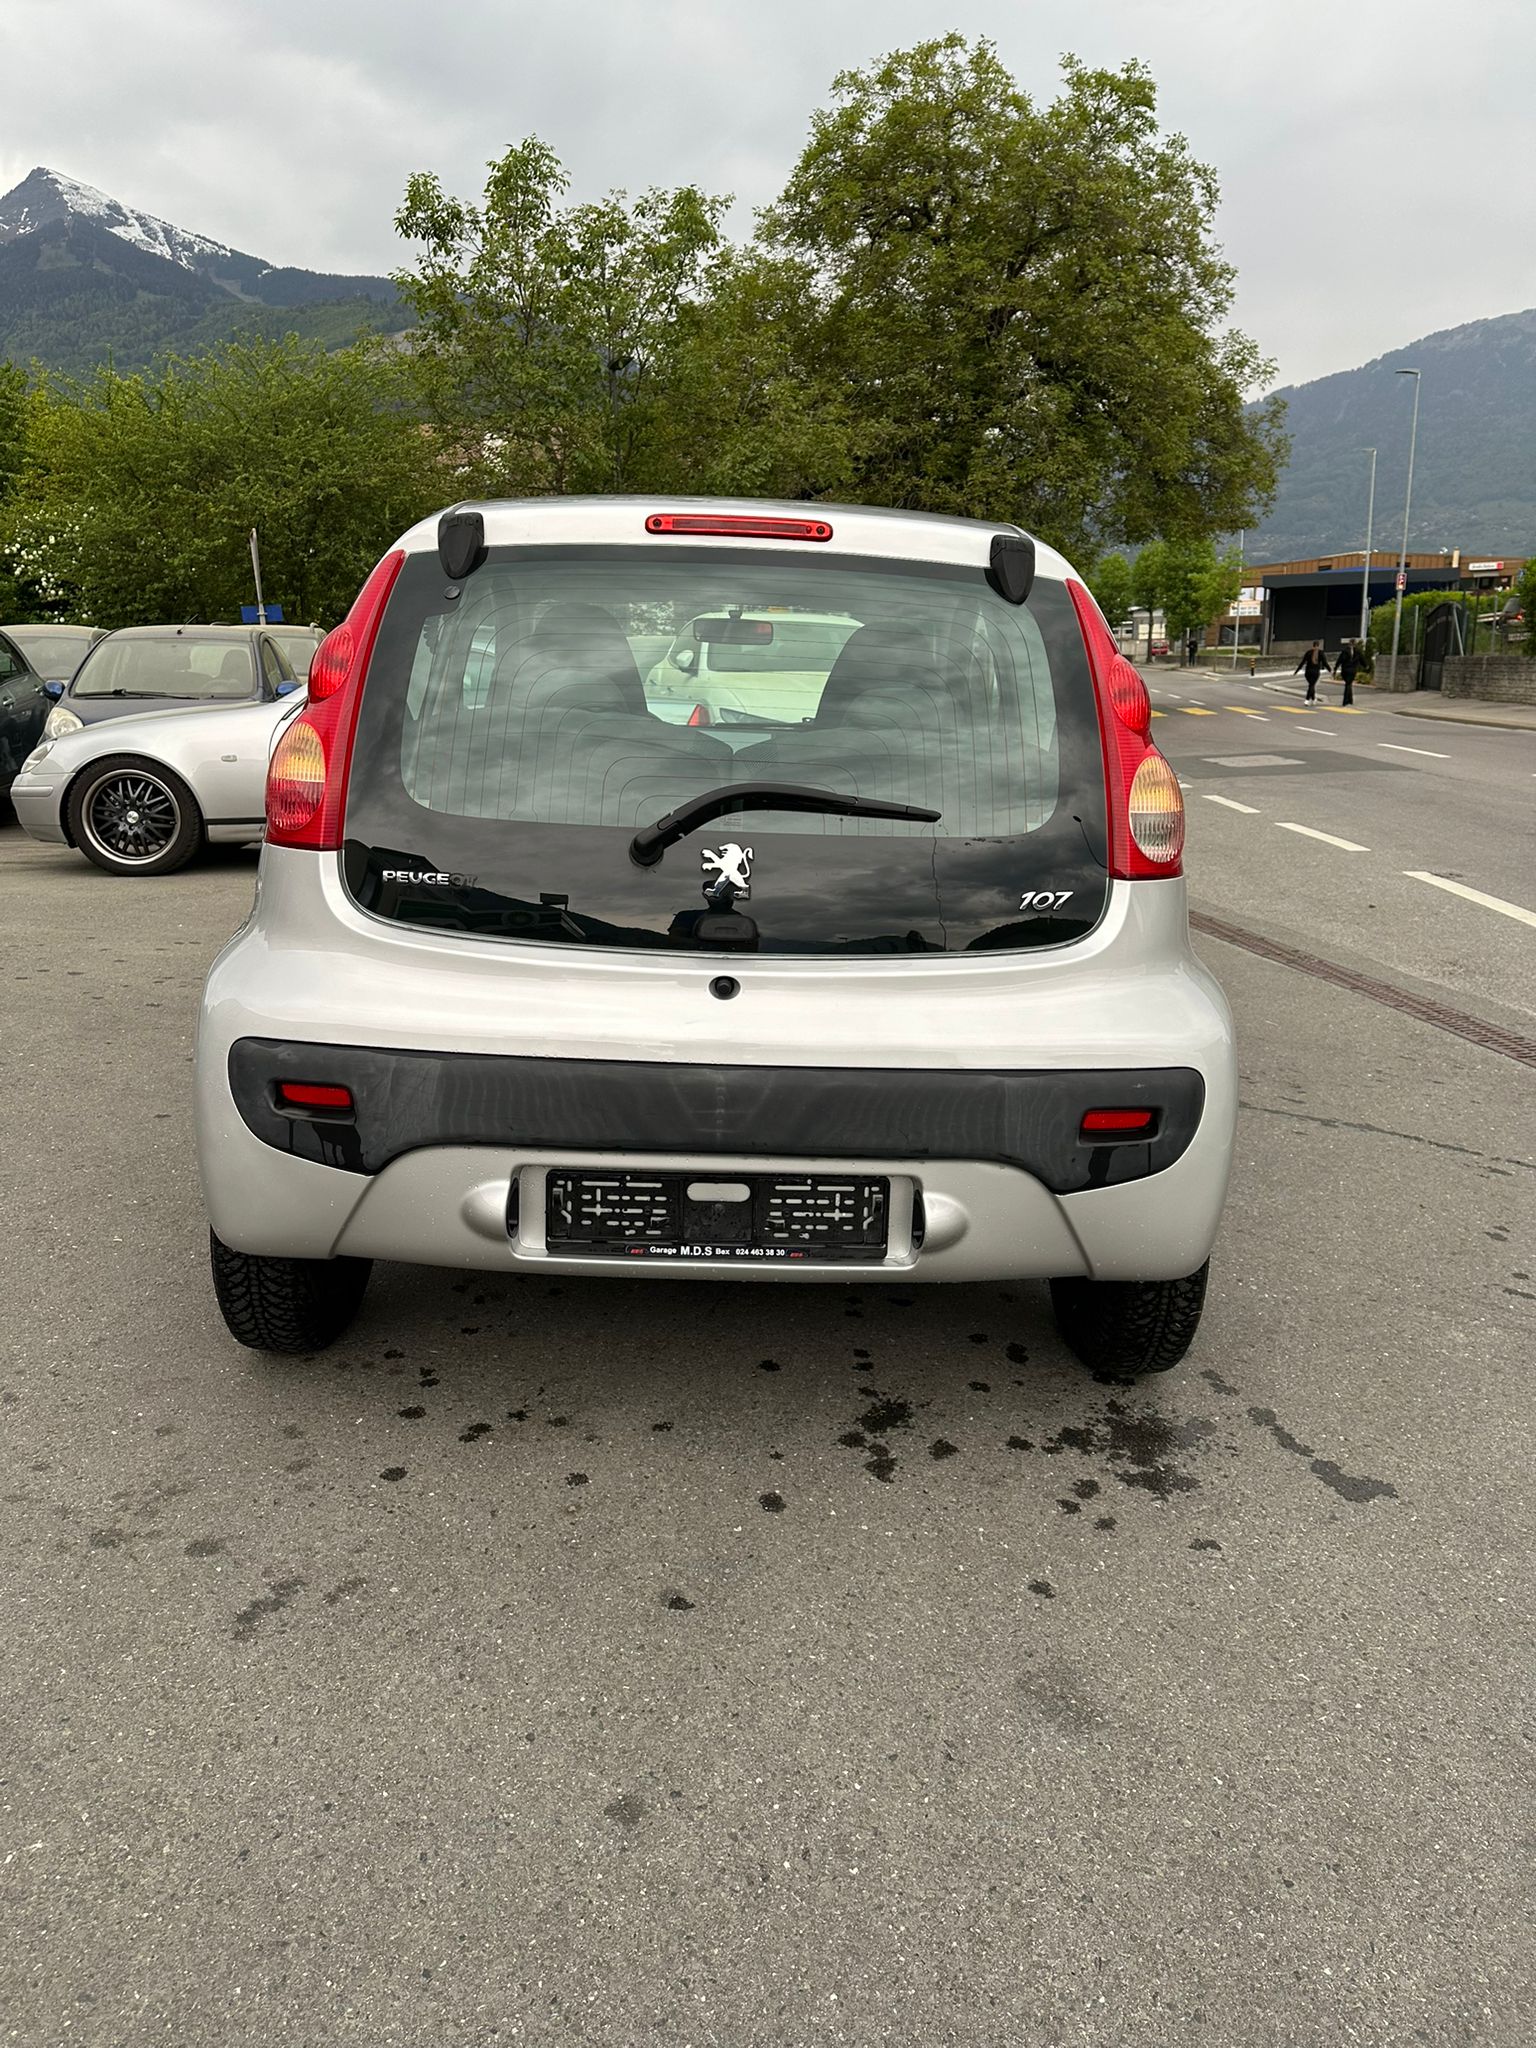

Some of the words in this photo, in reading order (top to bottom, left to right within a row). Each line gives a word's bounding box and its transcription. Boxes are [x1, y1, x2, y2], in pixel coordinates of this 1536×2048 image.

[1019, 891, 1073, 911] 107
[650, 1246, 677, 1255] Garage
[680, 1246, 713, 1256] M.D.S
[735, 1248, 749, 1256] 024
[750, 1248, 764, 1256] 463
[765, 1248, 775, 1256] 38
[776, 1248, 785, 1257] 30
